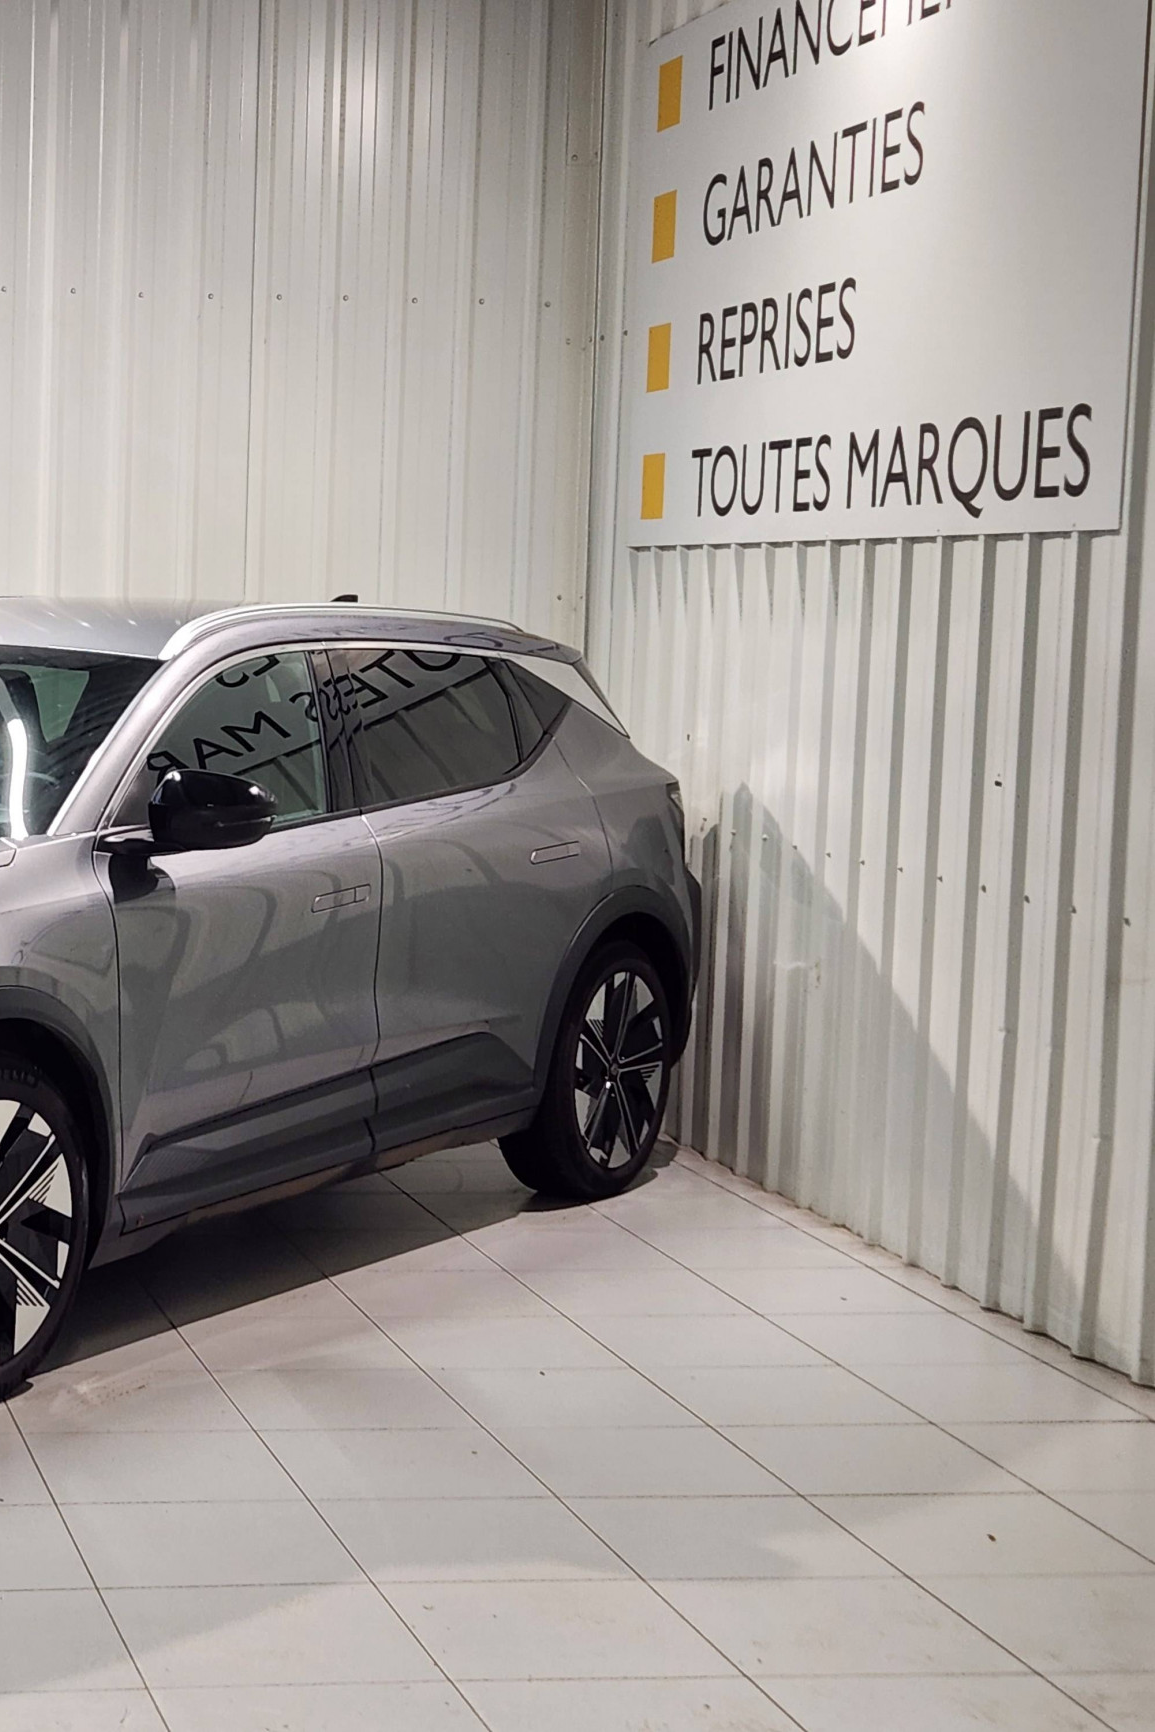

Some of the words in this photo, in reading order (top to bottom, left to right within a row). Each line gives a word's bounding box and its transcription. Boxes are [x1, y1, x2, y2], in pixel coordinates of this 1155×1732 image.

[703, 101, 926, 246] GARANTIES
[697, 277, 856, 385] REPRISES
[691, 434, 832, 517] TOUTES
[846, 402, 1093, 519] MARQUES
